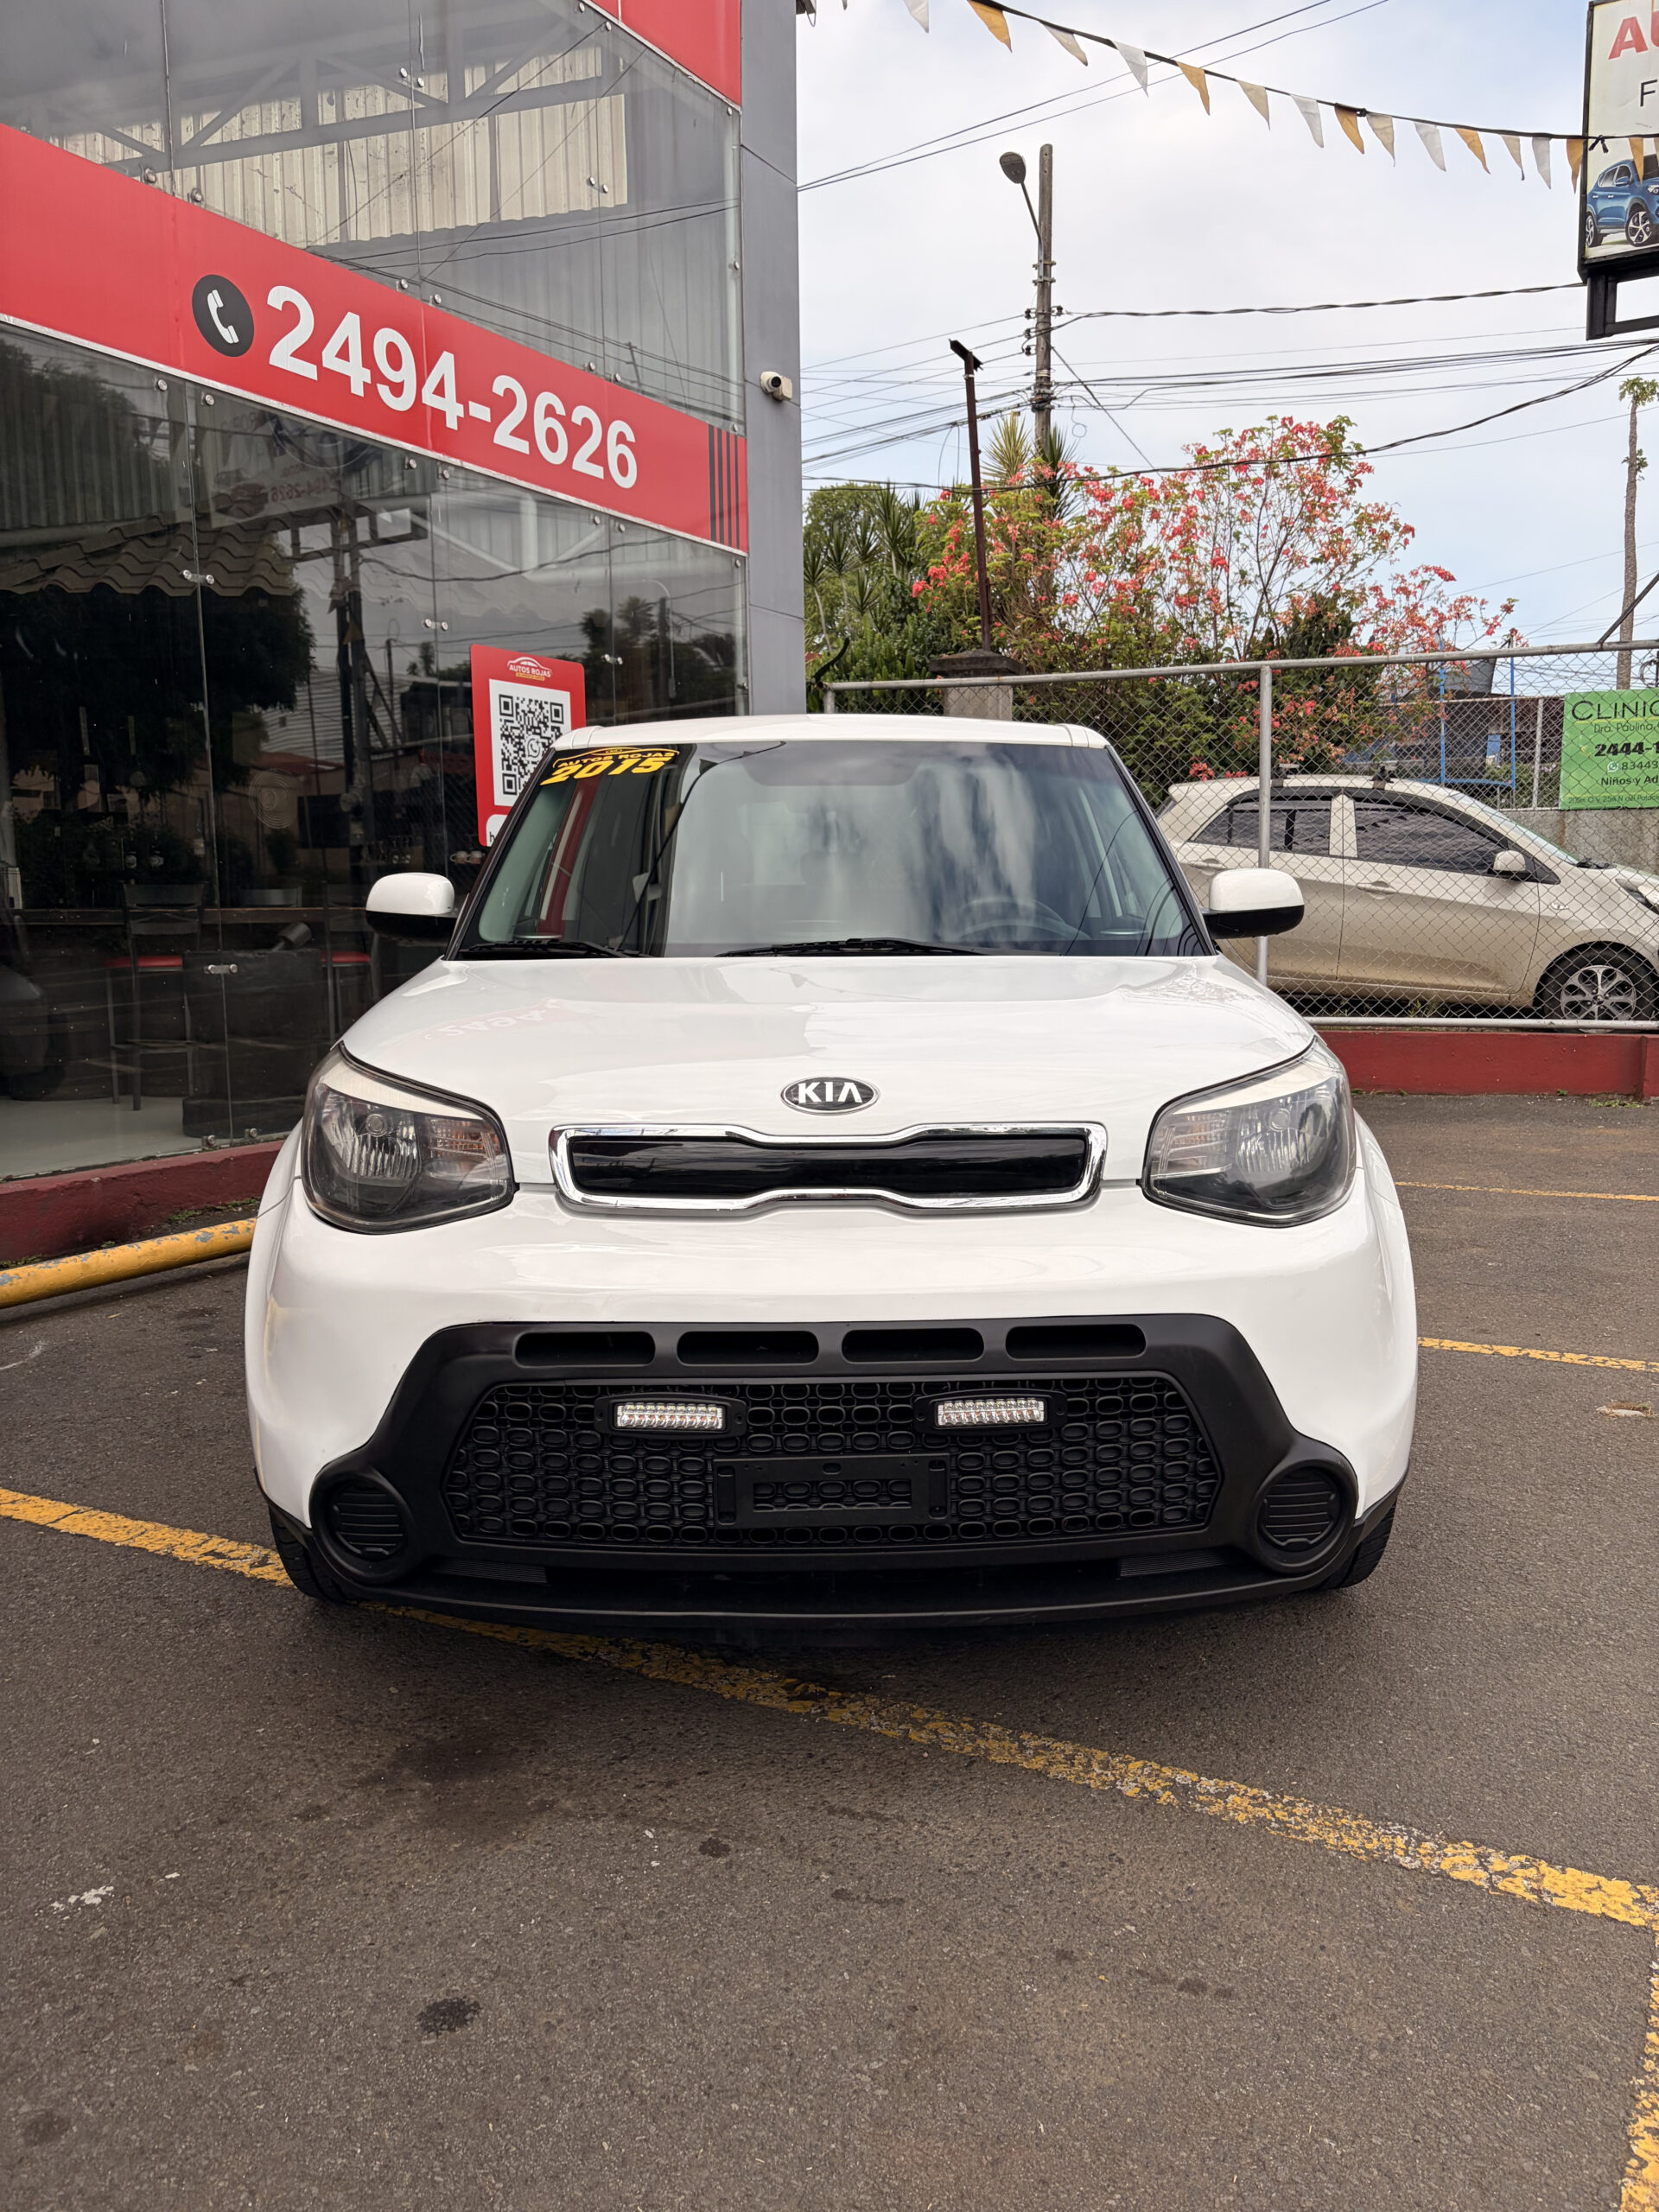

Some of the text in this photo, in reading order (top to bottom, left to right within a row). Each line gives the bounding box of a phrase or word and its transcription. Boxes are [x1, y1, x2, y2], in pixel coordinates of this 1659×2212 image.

[266, 285, 638, 488] 2494-2626
[509, 664, 531, 674] AUTOS
[531, 668, 551, 677] ROJAS
[1593, 723, 1613, 734] Dra.
[1617, 722, 1653, 732] Paulina
[558, 756, 613, 767] AUTOS
[539, 756, 672, 785] 2015
[1601, 775, 1658, 786] Niños y Ad
[798, 1081, 863, 1103] KIA
